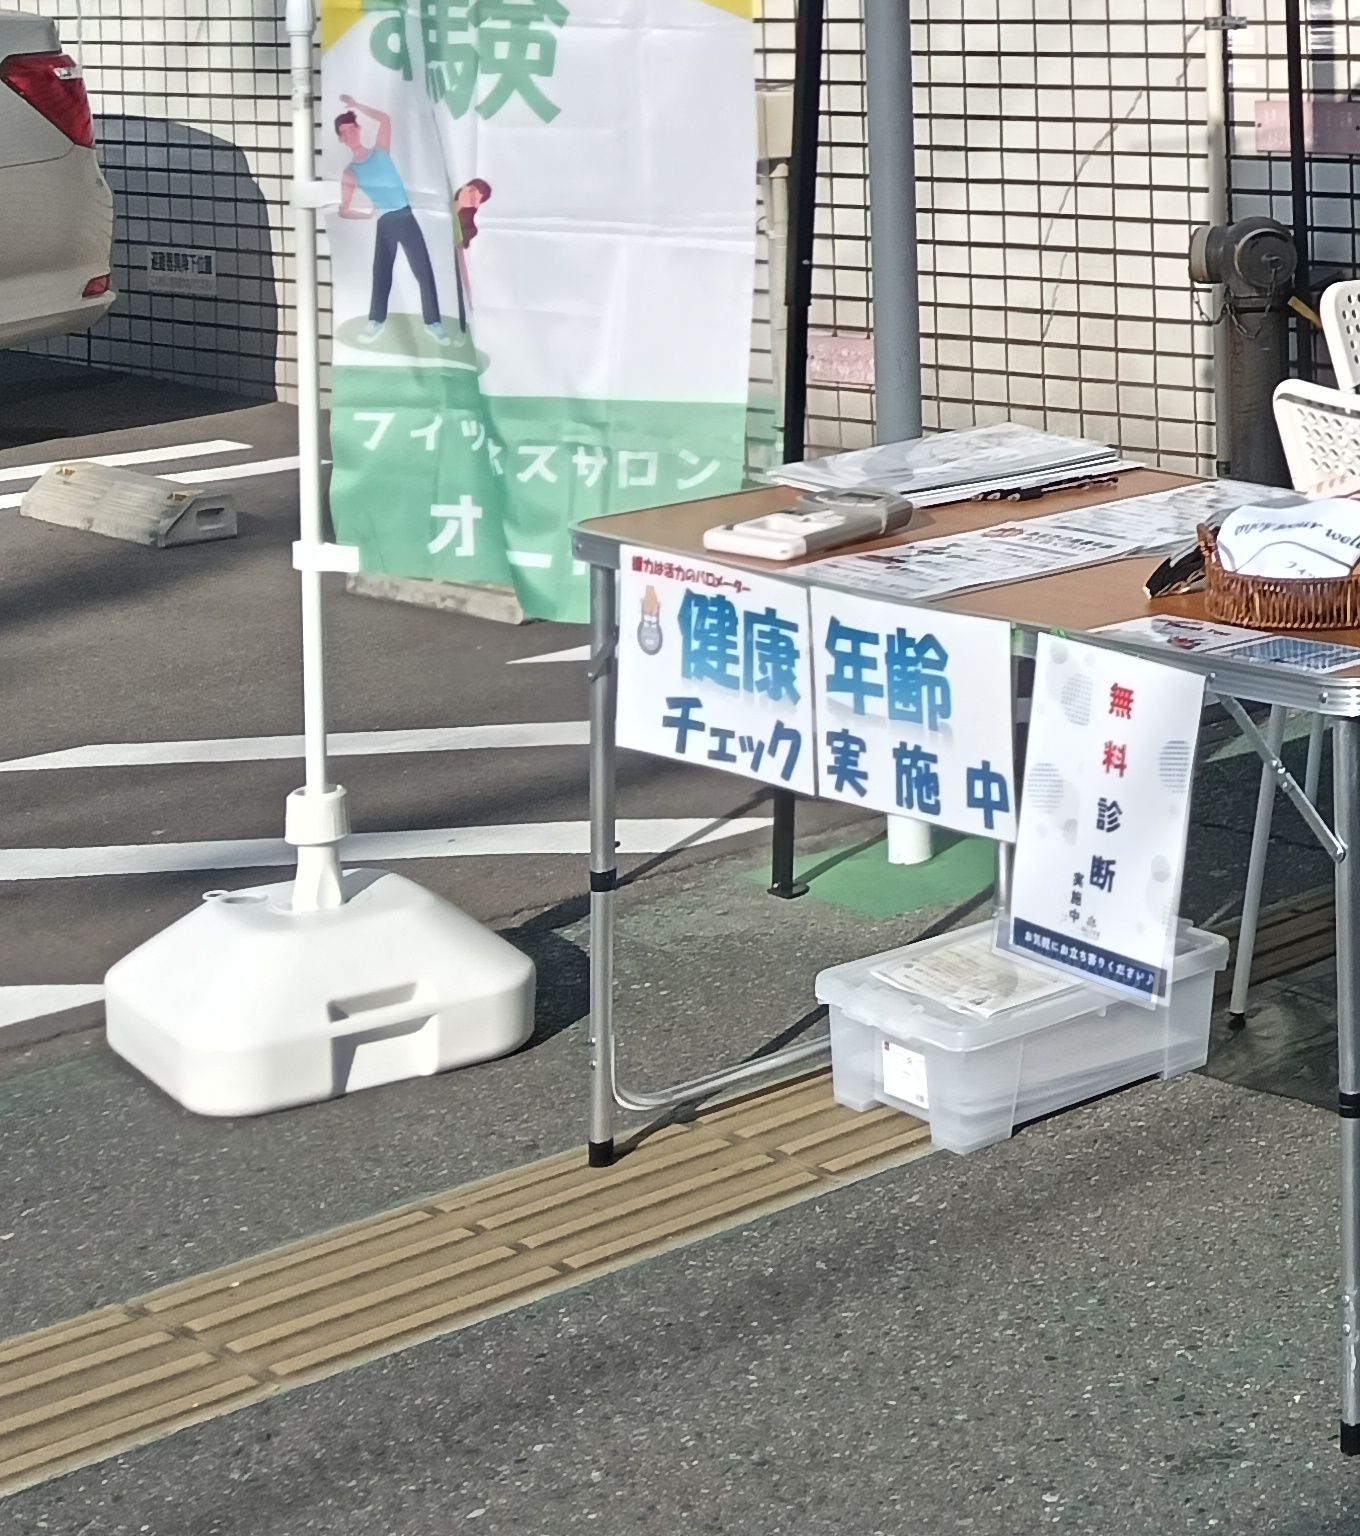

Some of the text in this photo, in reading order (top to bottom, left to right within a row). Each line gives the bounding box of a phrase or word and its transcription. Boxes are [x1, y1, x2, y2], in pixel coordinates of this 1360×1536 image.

[353, 411, 721, 491] フィッスサロン
[677, 587, 953, 732] 健康 年齢
[662, 696, 1011, 830] チェック 実施中
[1089, 682, 1135, 894] 無料診断
